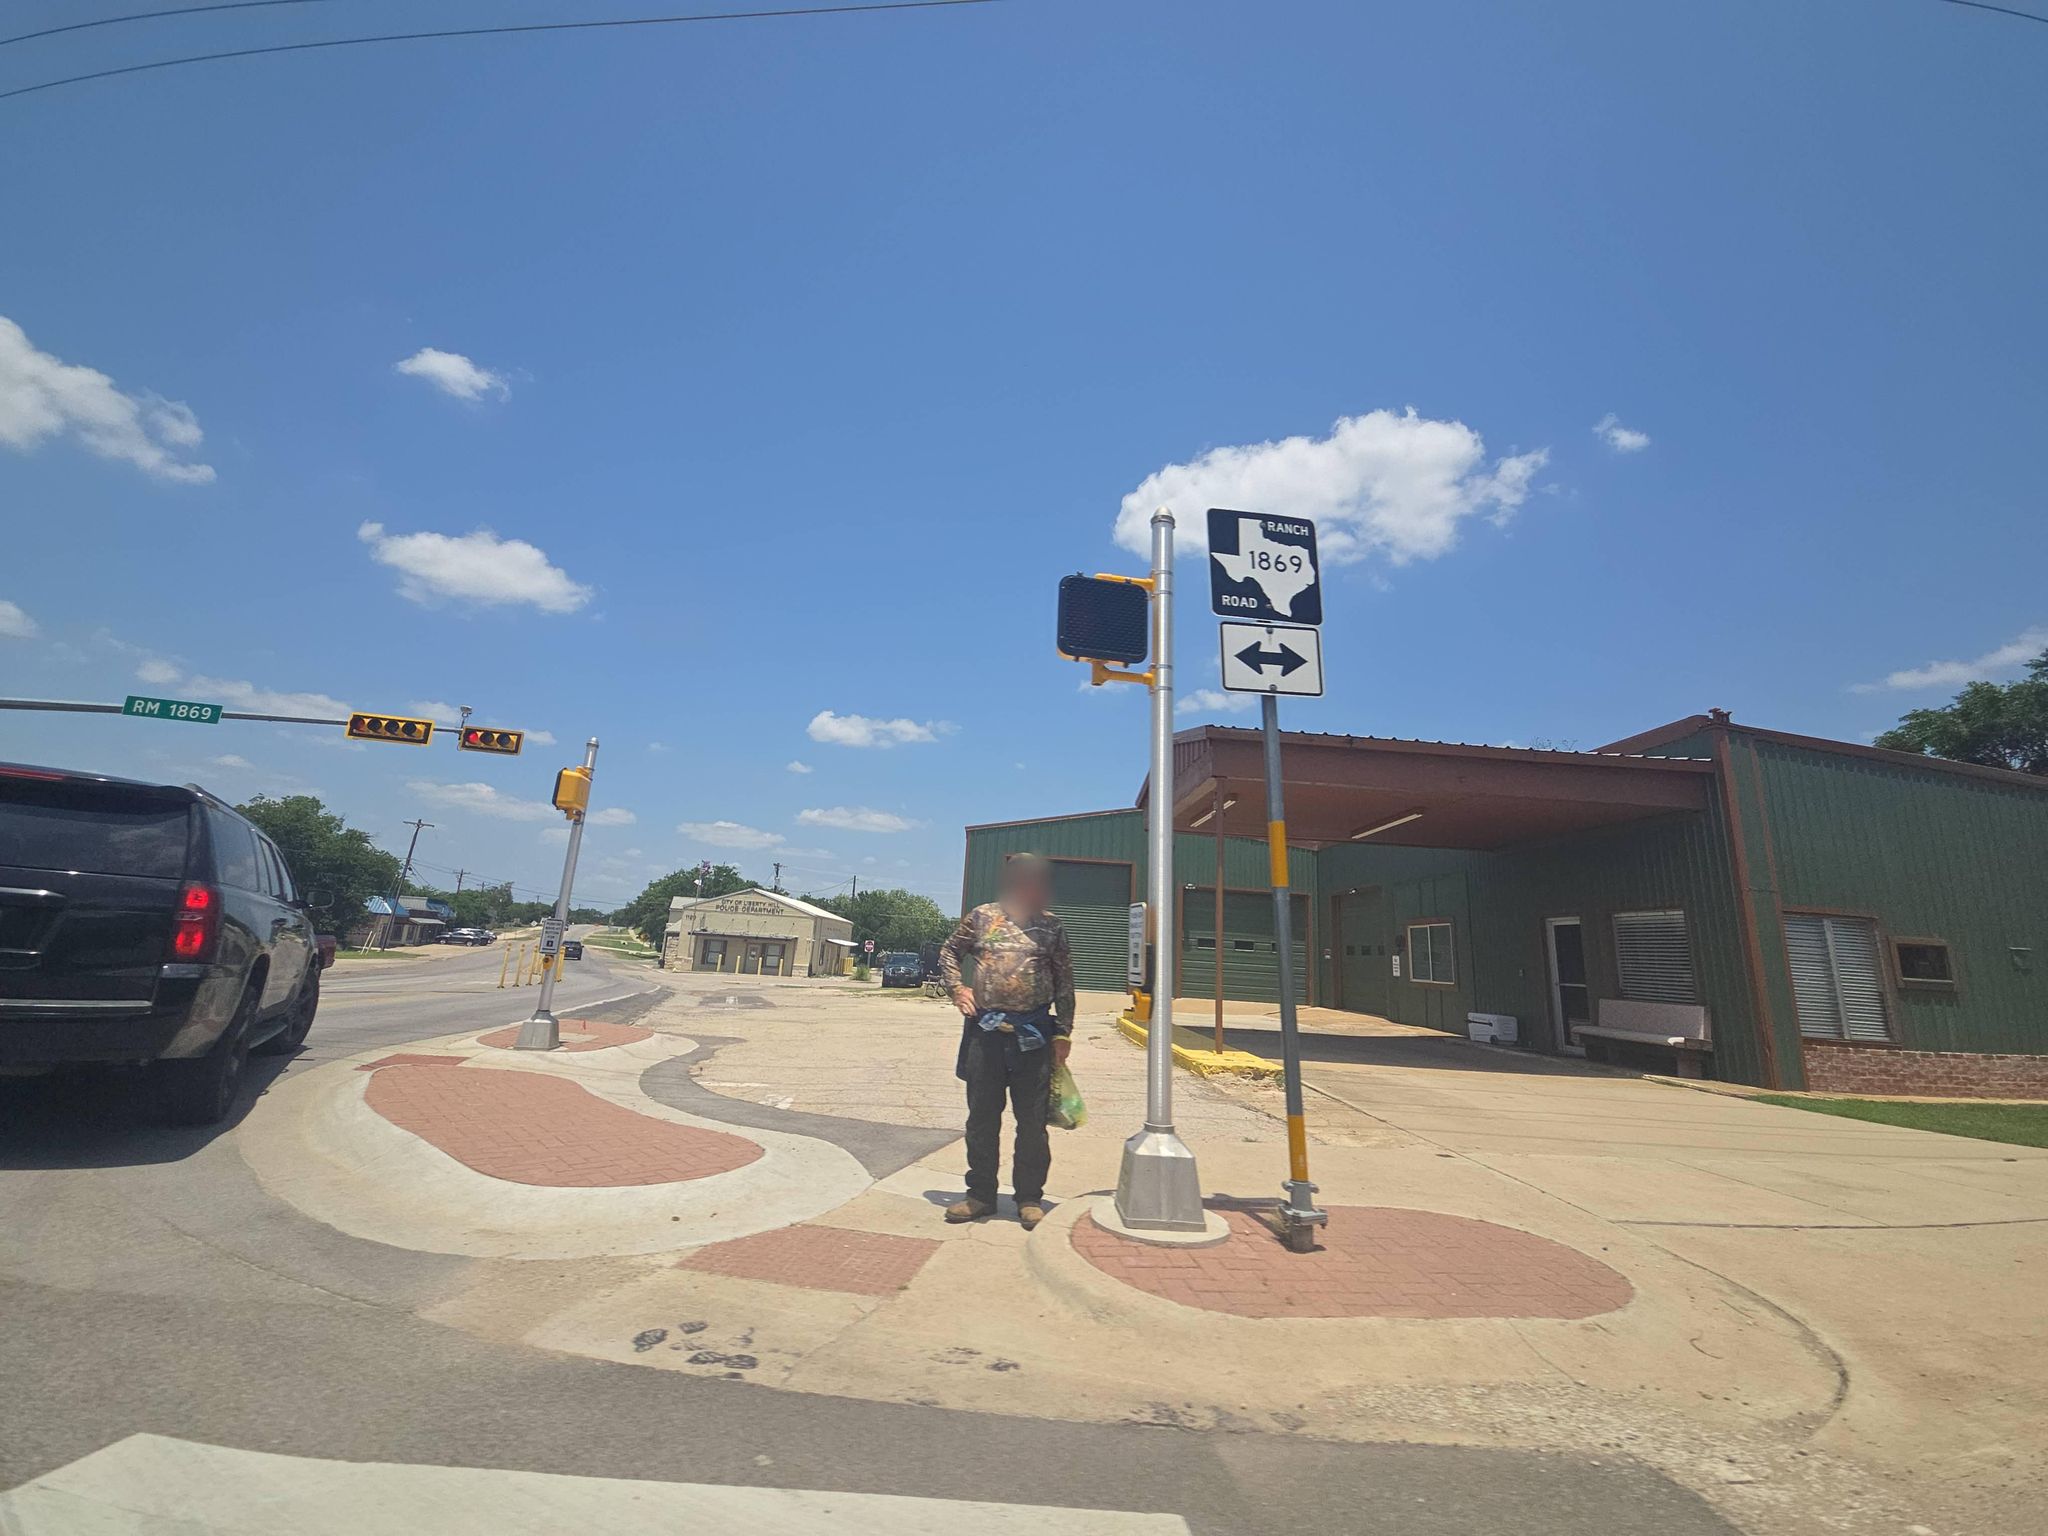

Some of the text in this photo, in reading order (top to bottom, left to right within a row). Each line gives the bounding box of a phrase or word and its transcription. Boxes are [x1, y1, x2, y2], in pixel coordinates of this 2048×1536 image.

[1267, 521, 1309, 536] RANCH
[1249, 551, 1302, 573] 1869
[1222, 595, 1258, 609] ROAD
[133, 700, 211, 719] RM 1869
[742, 907, 784, 915] DEPARTMENT
